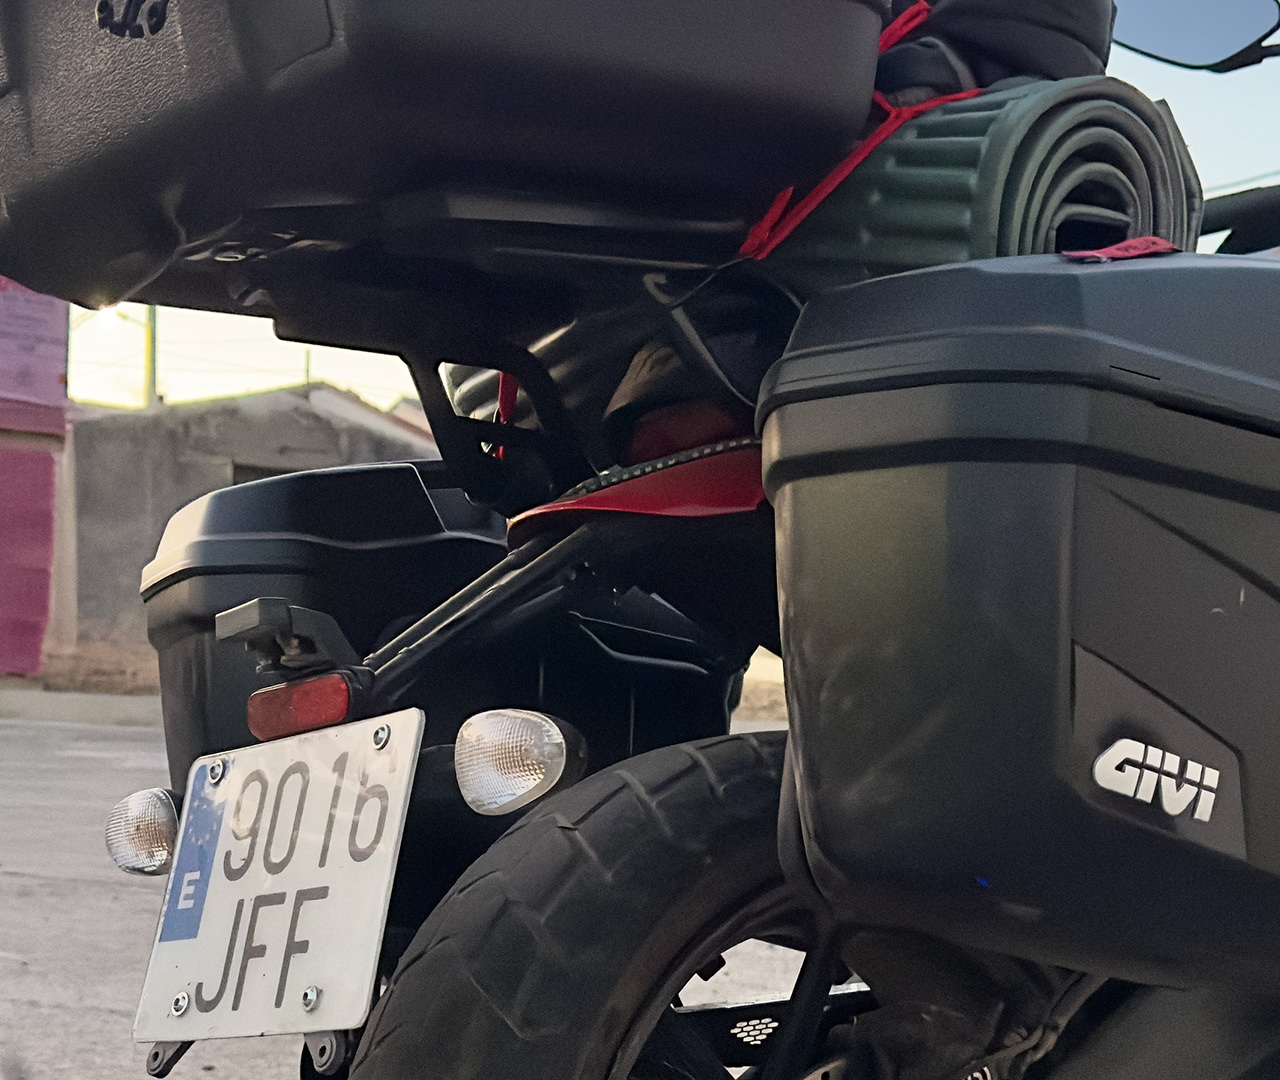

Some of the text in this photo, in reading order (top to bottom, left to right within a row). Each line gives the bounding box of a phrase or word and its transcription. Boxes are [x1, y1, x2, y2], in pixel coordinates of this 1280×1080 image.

[223, 751, 390, 882] 9016
[1092, 737, 1220, 823] GIVI
[177, 870, 201, 910] E
[195, 885, 329, 1013] JFF
